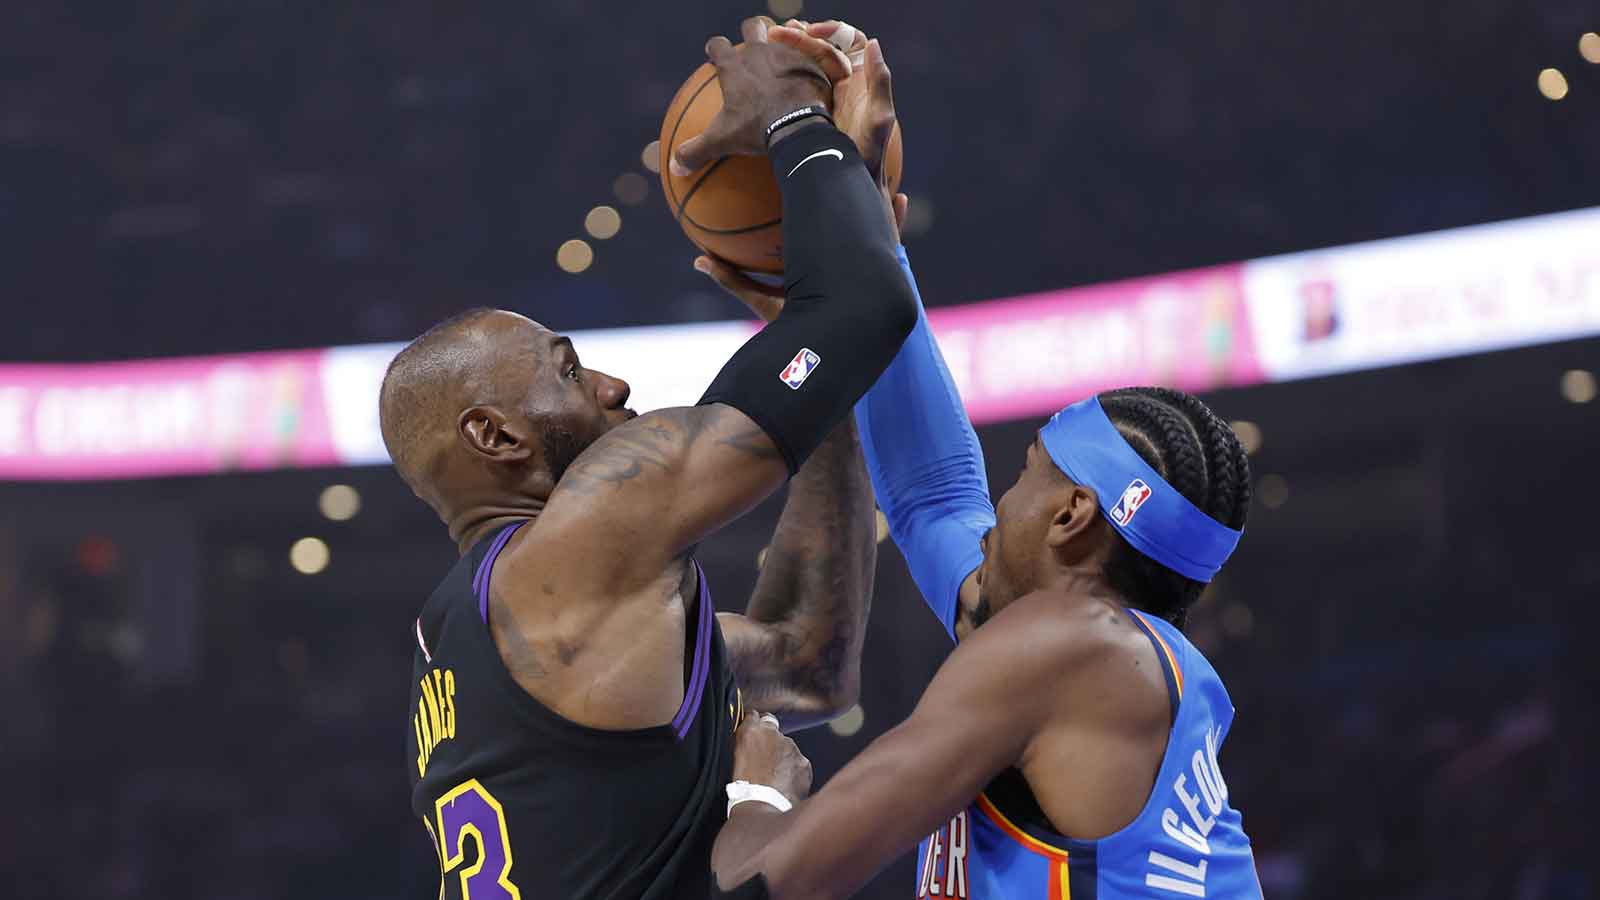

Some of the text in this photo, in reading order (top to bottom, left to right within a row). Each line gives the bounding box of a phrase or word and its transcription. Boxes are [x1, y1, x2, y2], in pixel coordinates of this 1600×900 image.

[770, 107, 812, 130] PROMISE
[414, 668, 456, 779] JAMES
[423, 777, 523, 900] 3
